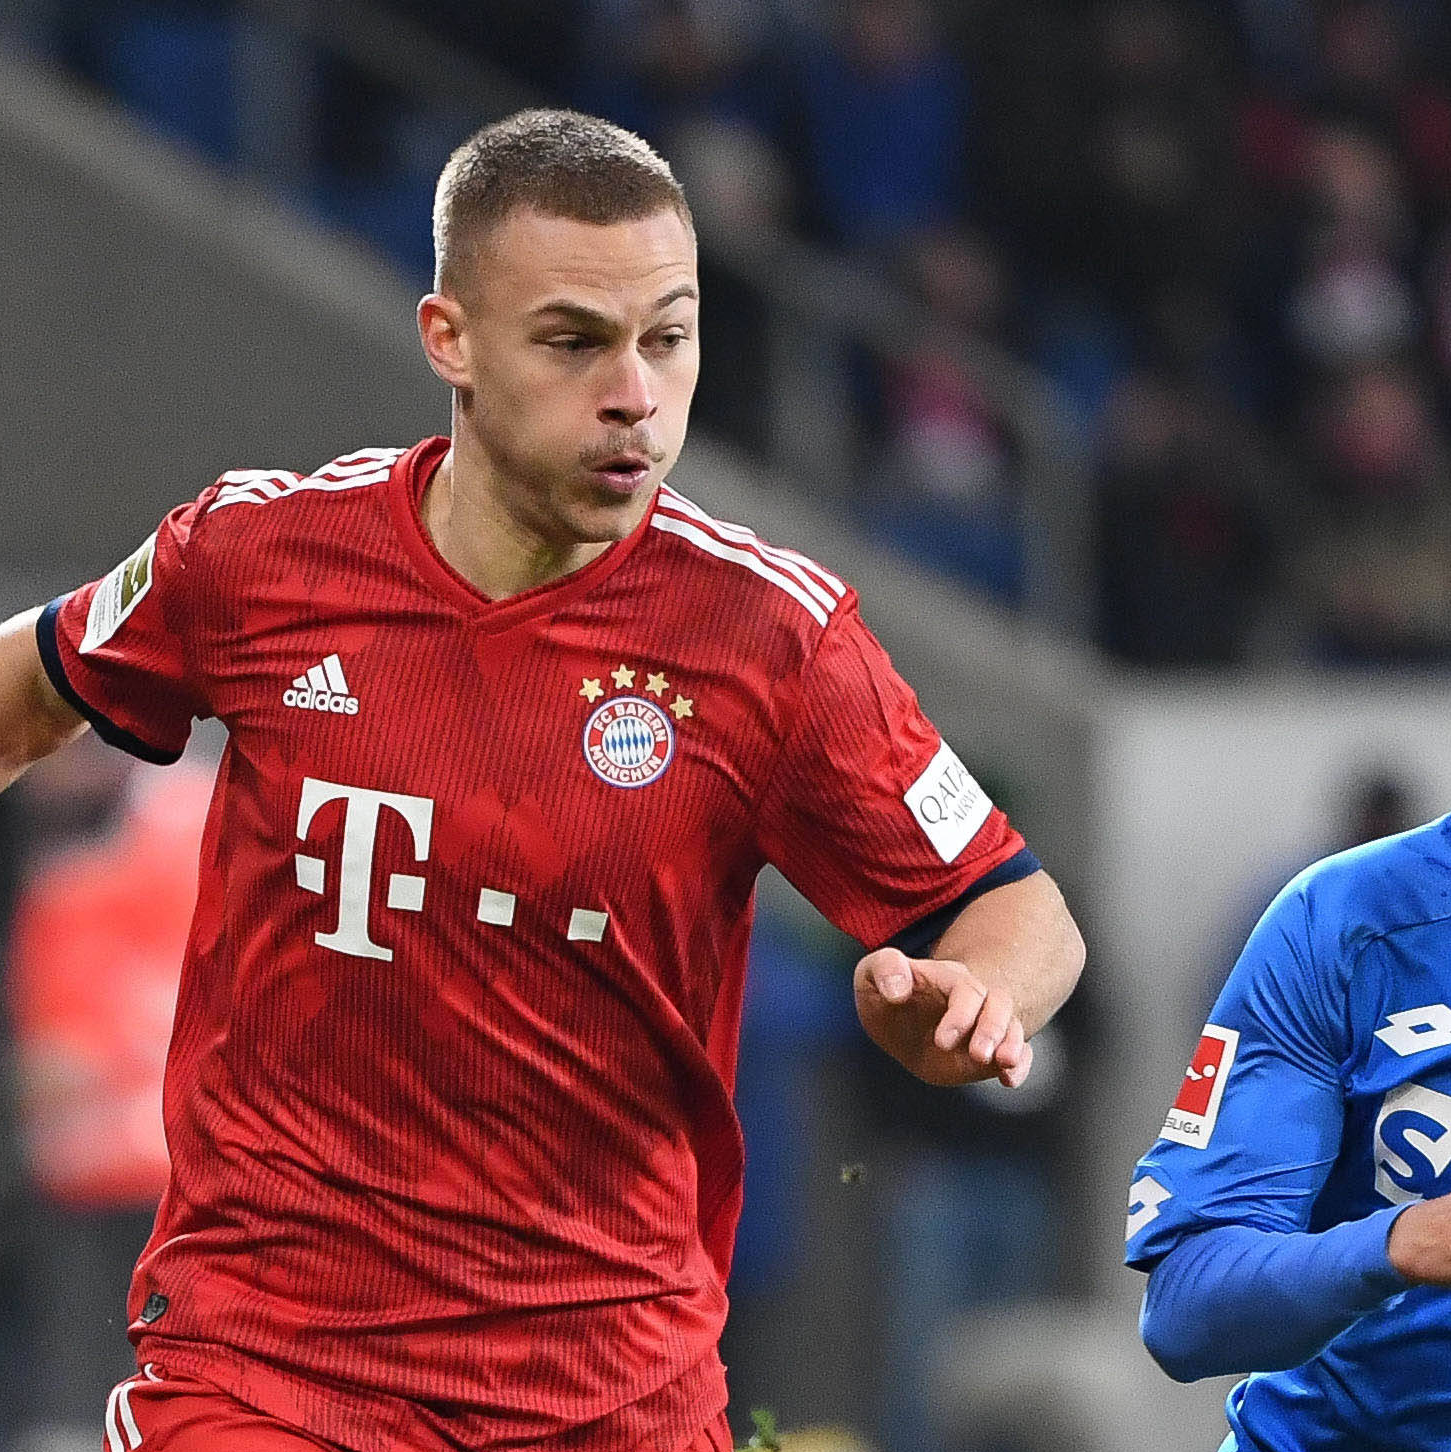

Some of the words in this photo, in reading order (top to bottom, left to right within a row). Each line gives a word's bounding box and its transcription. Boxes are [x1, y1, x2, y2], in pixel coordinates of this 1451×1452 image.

[283, 688, 359, 715] adidas
[593, 711, 613, 732] FC
[614, 703, 667, 742] BAYERN
[919, 761, 969, 825] QATA
